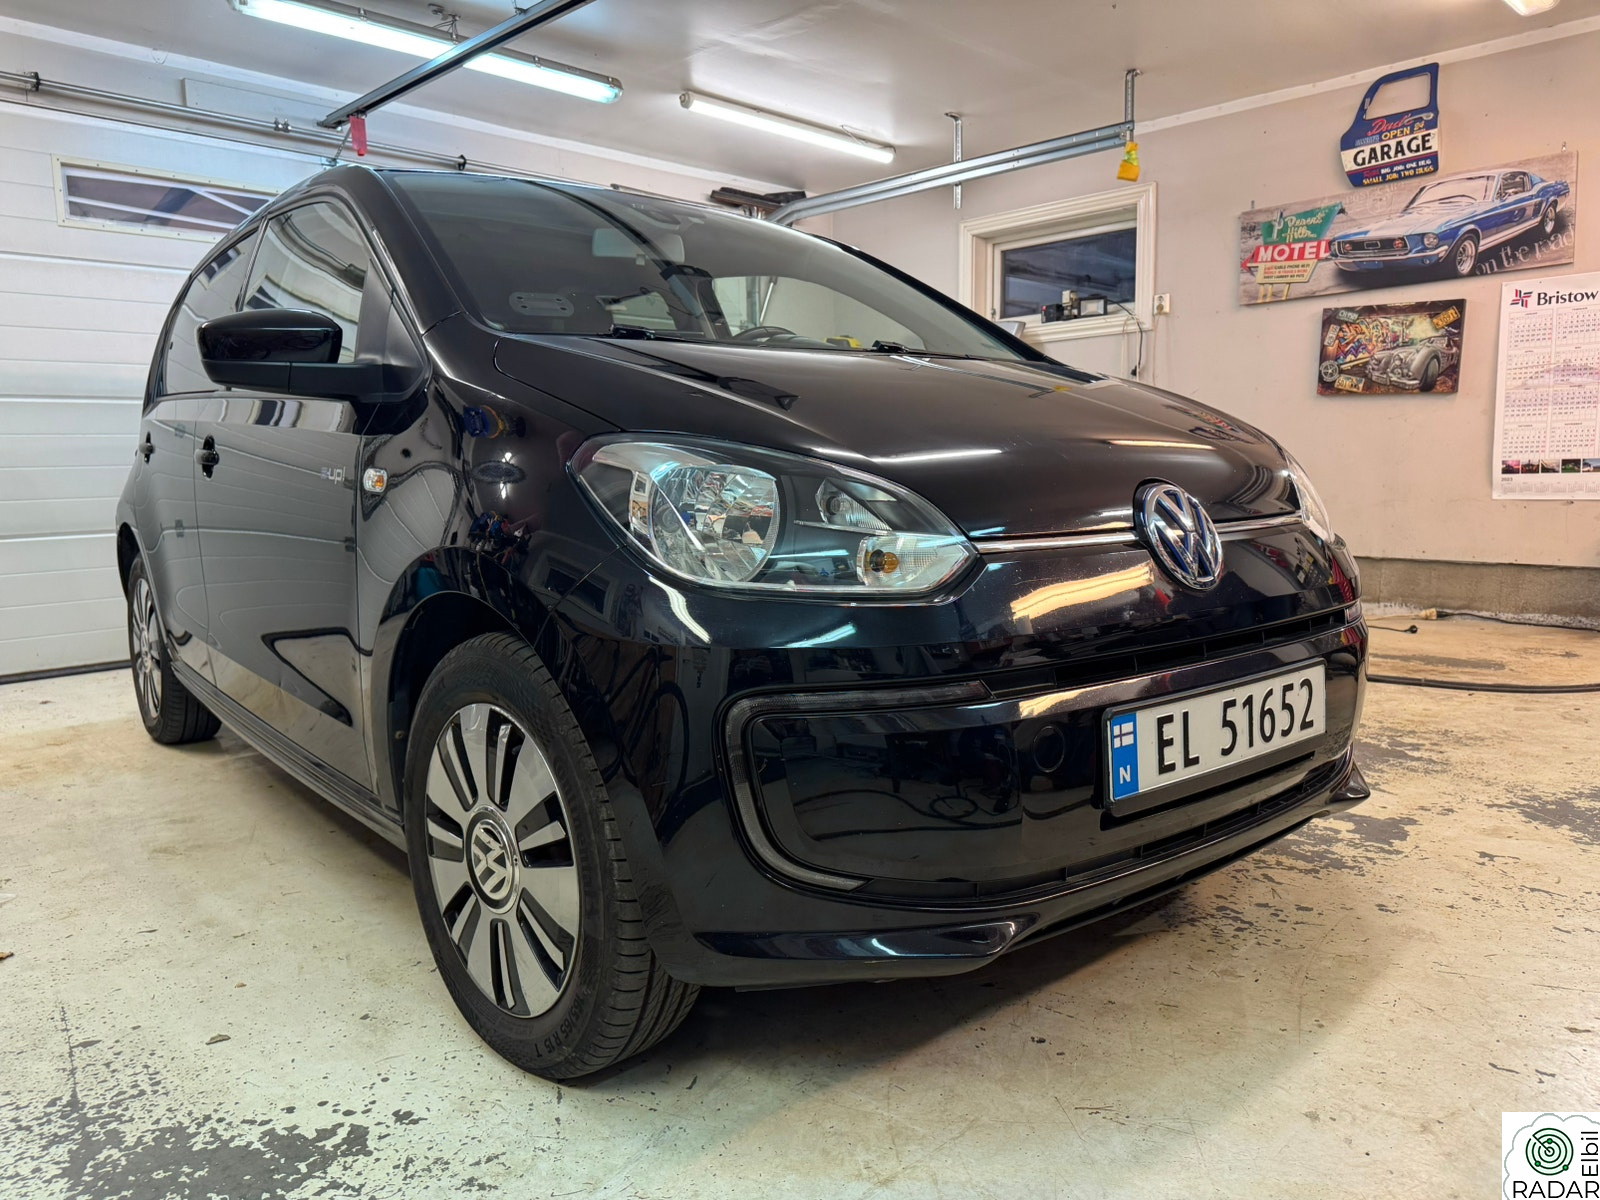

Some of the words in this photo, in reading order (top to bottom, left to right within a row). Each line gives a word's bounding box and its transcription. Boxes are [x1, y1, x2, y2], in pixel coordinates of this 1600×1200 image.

[1381, 126, 1411, 141] OPEN
[1353, 132, 1433, 167] GARAGE
[1362, 176, 1383, 185] SMALL
[1401, 169, 1415, 177] TWO
[1380, 167, 1391, 175] BIG
[1257, 240, 1330, 262] MOTEL
[1475, 258, 1498, 275] on
[1500, 245, 1530, 268] the
[1535, 223, 1575, 260] road
[1537, 290, 1599, 306] Bristow
[1156, 709, 1200, 775] EL
[1220, 677, 1314, 757] 51652
[1119, 764, 1132, 785] N
